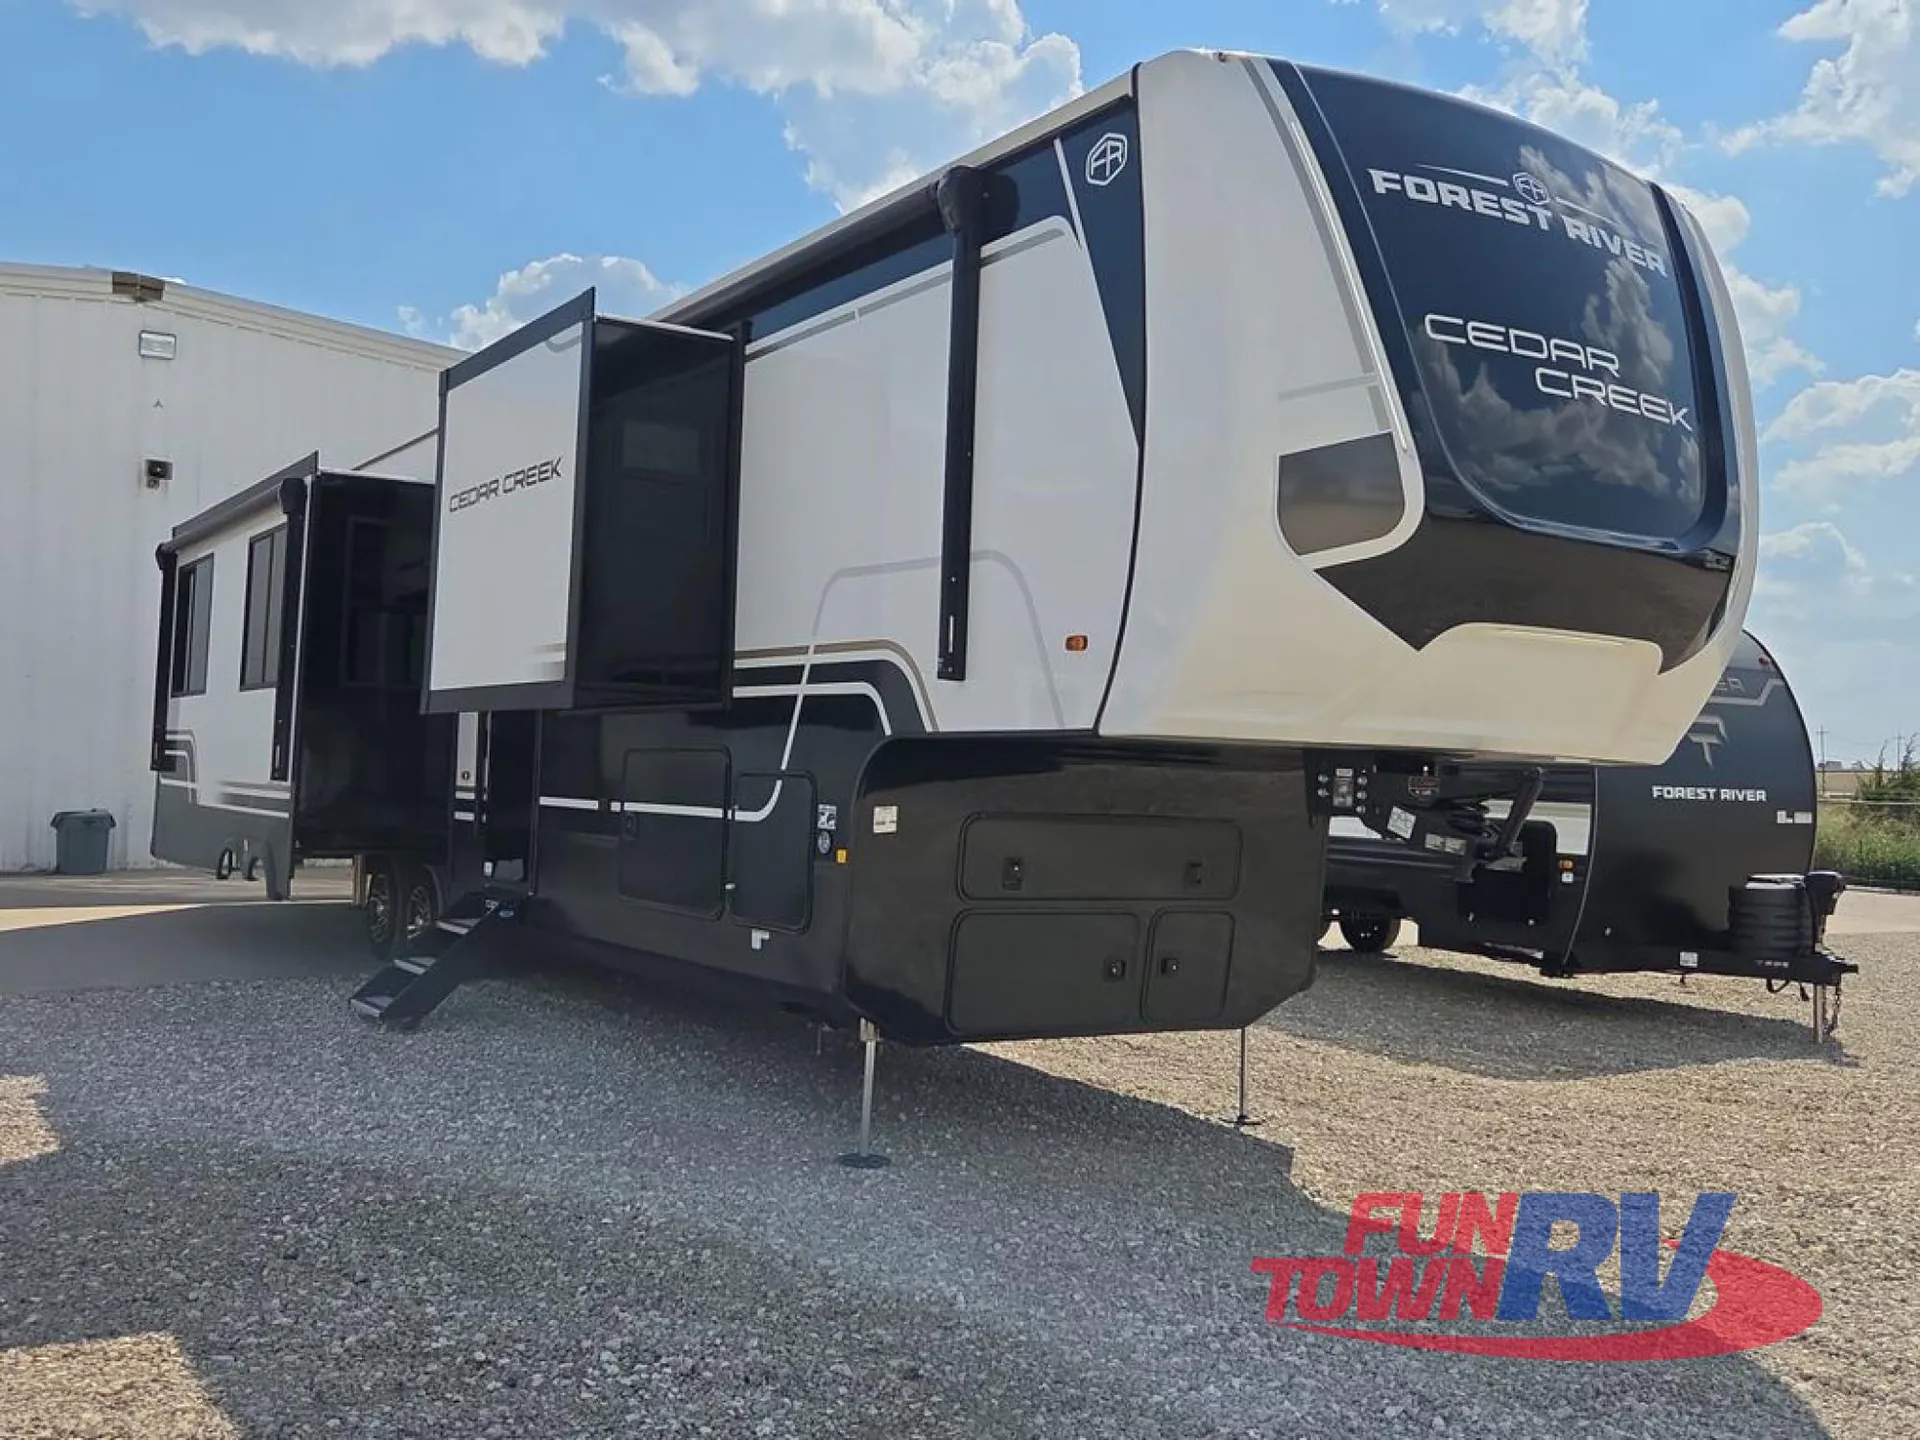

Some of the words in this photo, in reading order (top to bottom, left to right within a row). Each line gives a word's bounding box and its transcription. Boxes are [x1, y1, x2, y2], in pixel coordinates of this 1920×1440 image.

[1367, 168, 1551, 231] FOREST
[1559, 213, 1668, 278] RIVER
[1424, 312, 1620, 377] CEDAR
[1535, 366, 1693, 432] CREEK
[449, 478, 499, 513] CEDAR
[503, 456, 562, 494] CREEK
[1652, 785, 1717, 800] FOREST
[1720, 788, 1767, 801] RIVER
